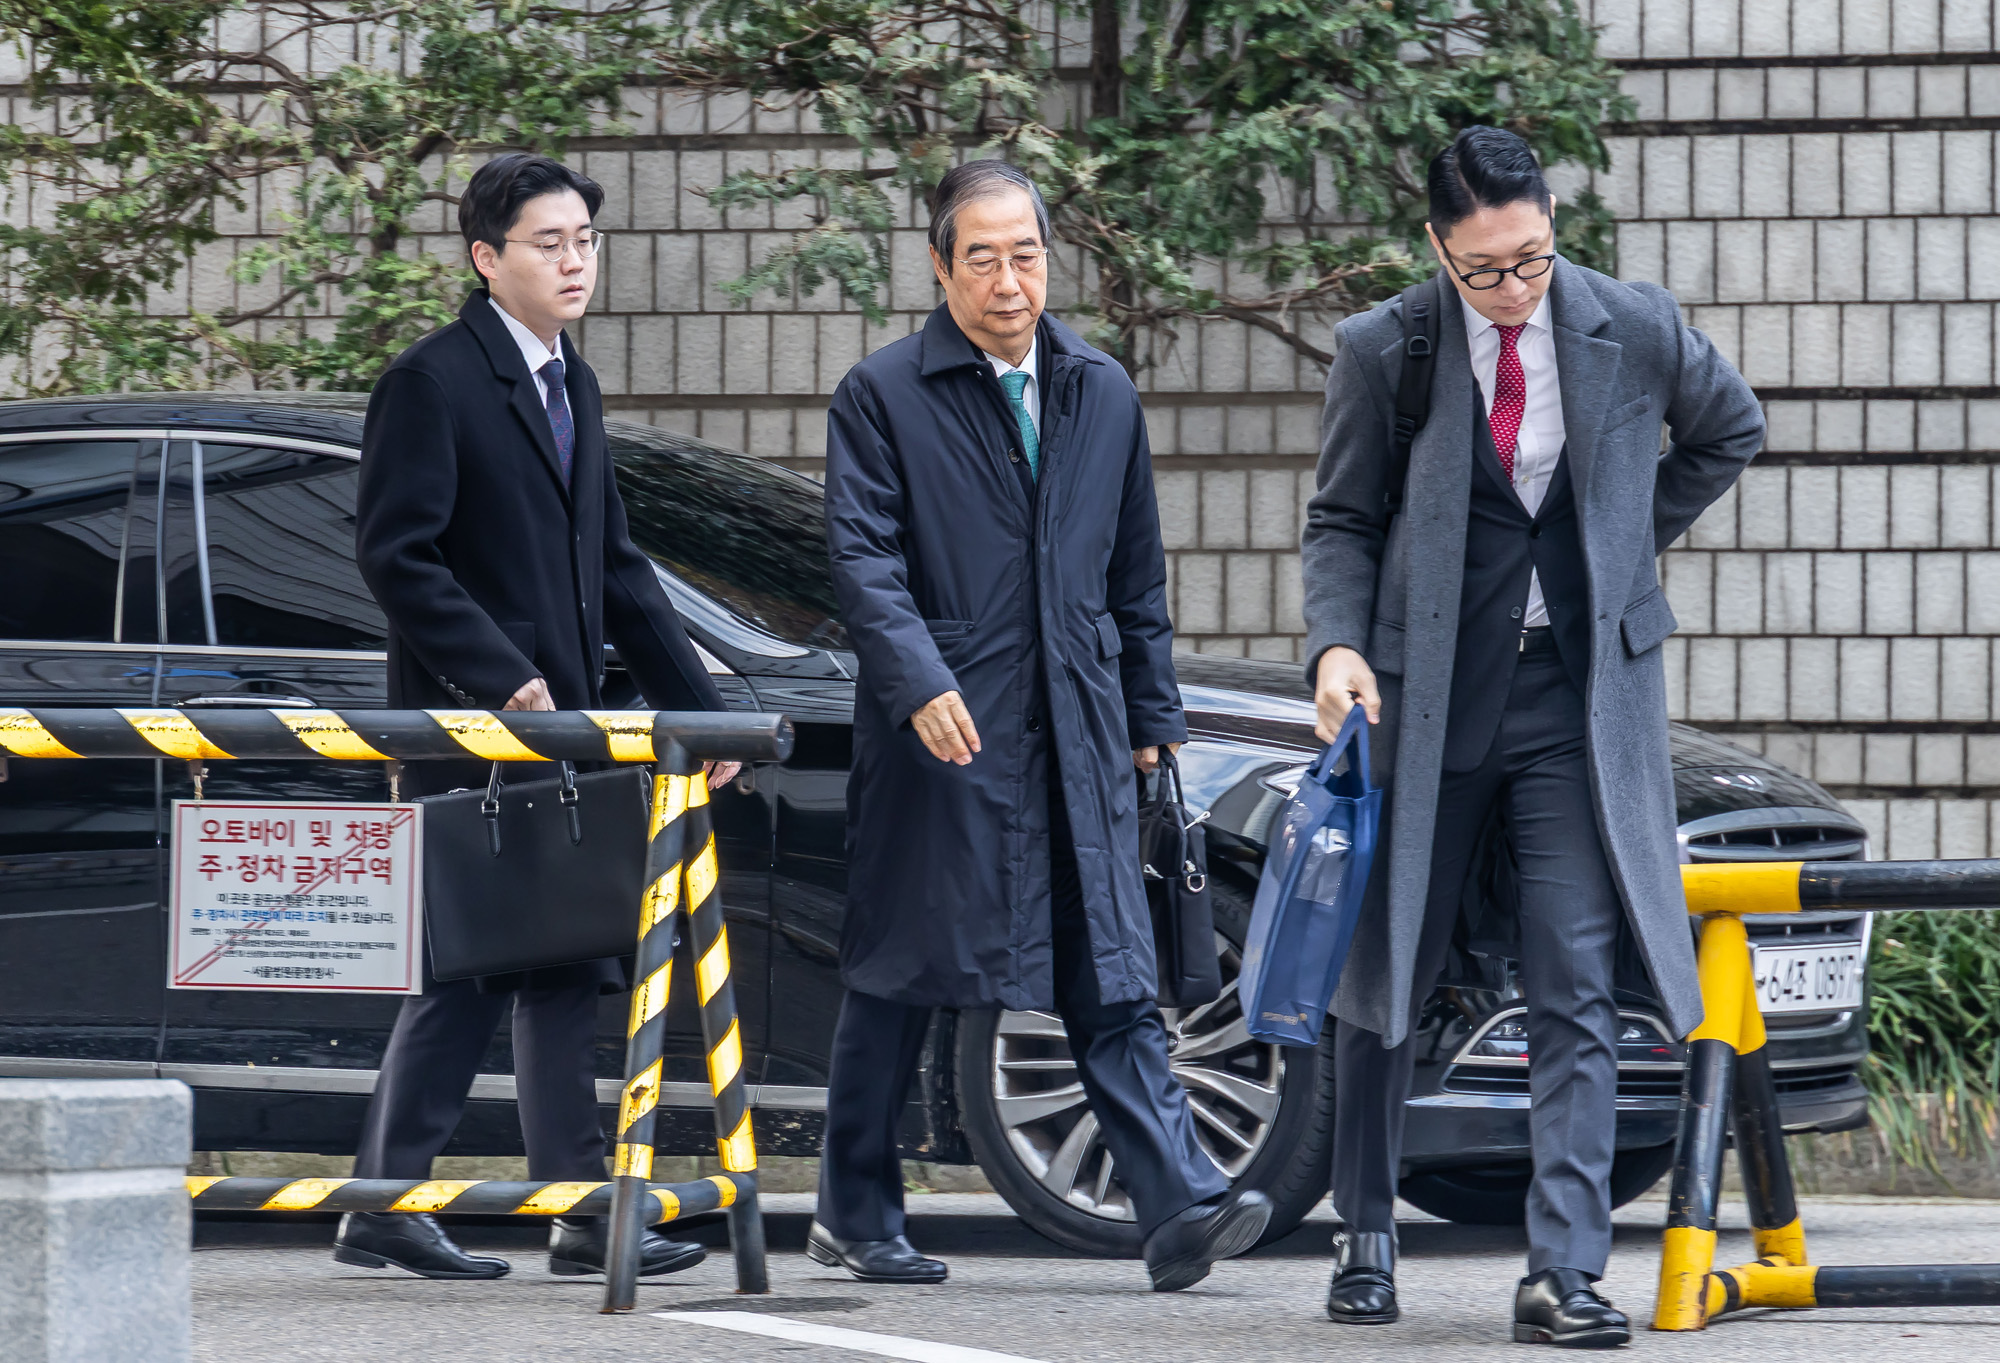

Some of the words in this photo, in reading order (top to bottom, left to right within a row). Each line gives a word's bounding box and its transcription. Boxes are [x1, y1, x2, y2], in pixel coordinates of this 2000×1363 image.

[198, 819, 296, 847] 오토바이
[308, 820, 332, 848] 및
[345, 821, 394, 850] 차량
[292, 856, 393, 885] 금지구역
